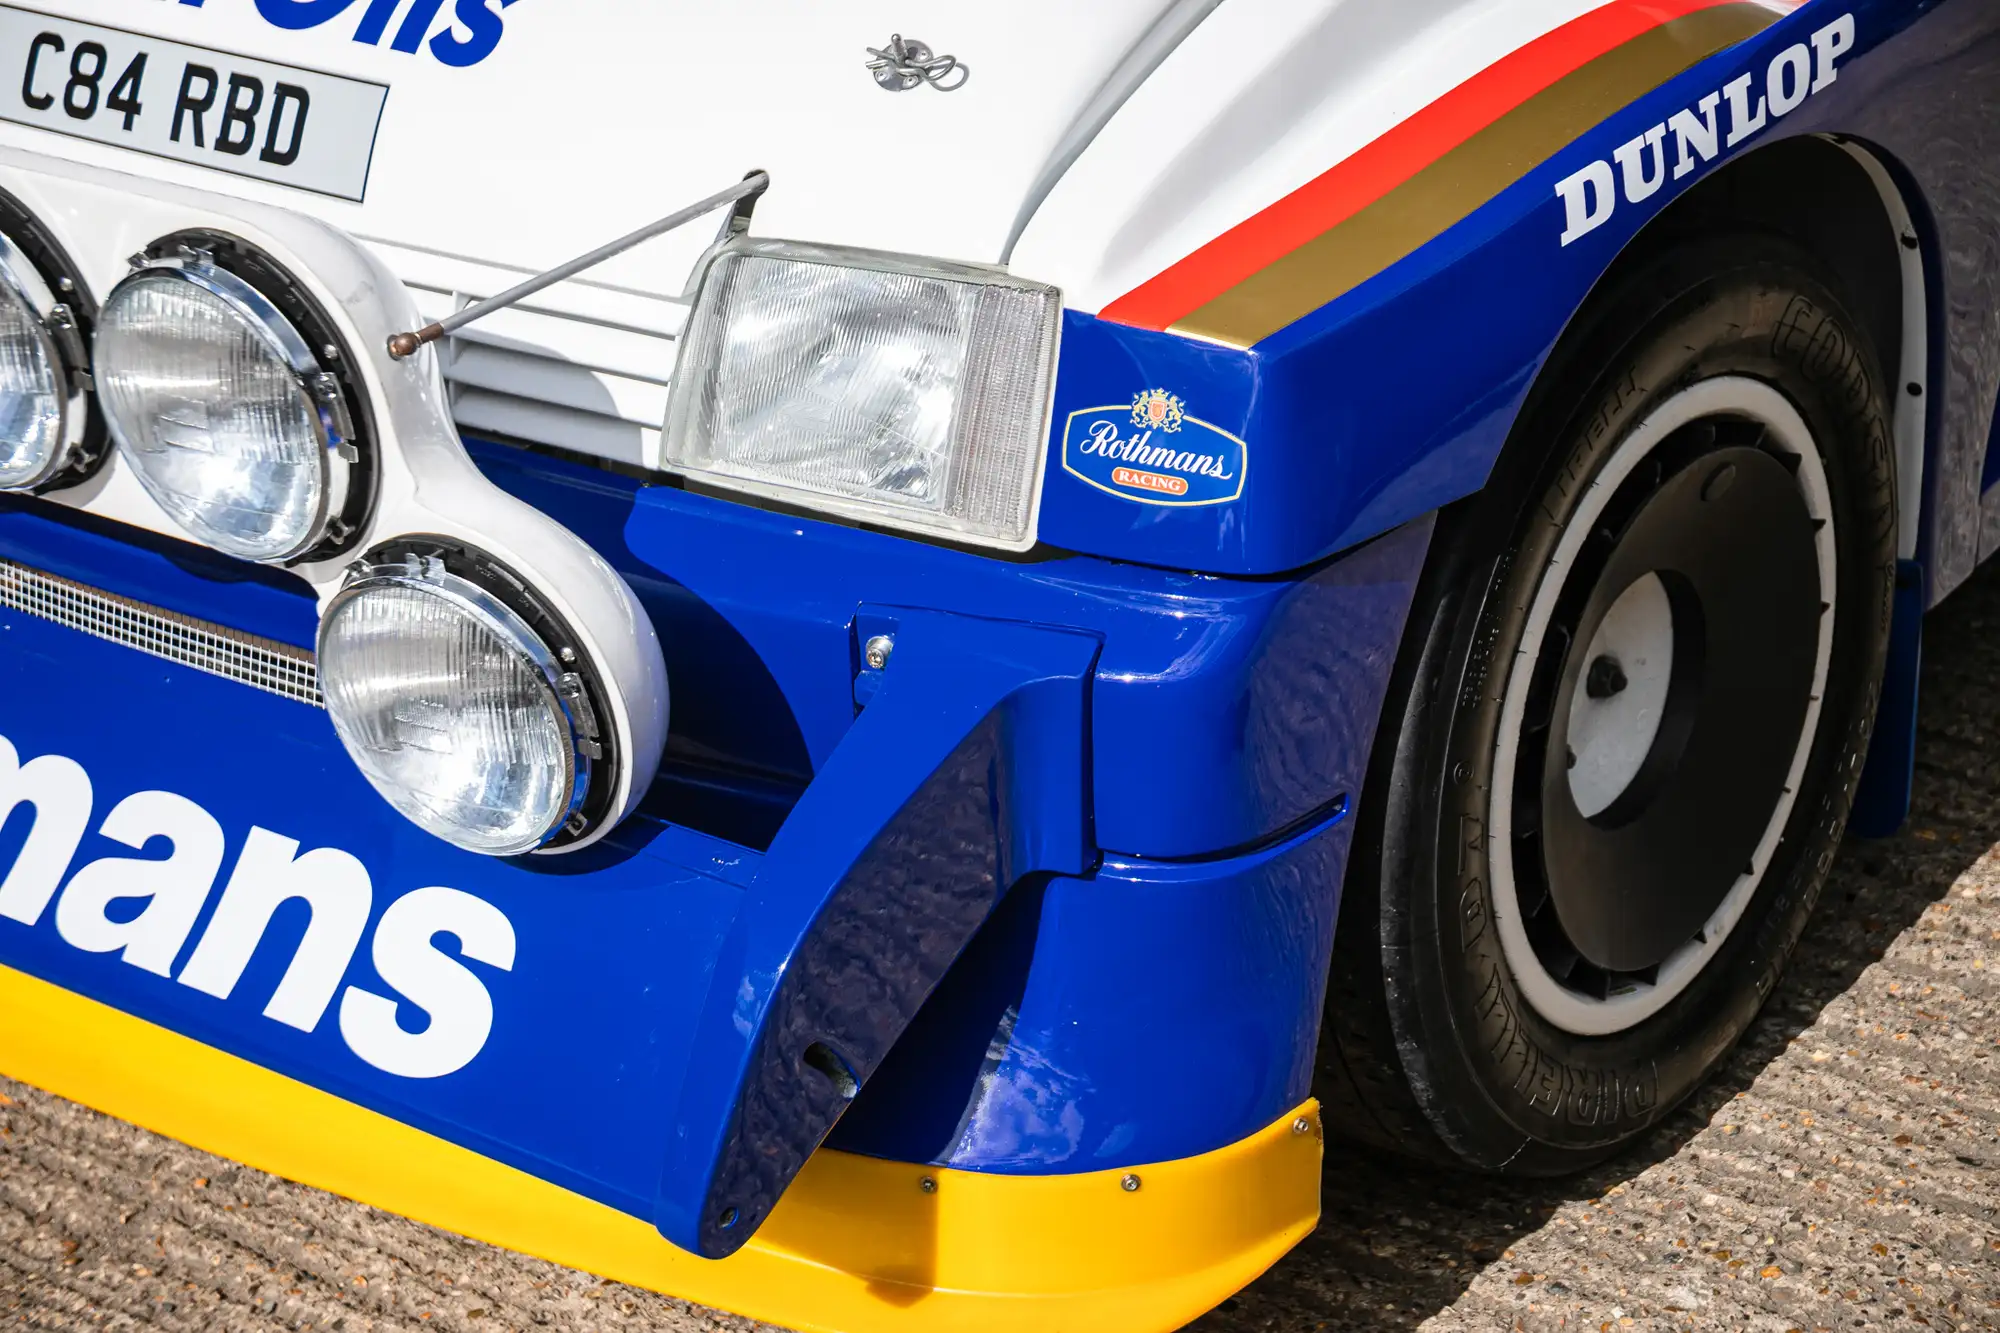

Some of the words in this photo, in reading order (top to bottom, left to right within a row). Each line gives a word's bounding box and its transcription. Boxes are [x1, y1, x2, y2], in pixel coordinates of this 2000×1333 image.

[21, 31, 149, 132] C84
[169, 62, 311, 167] RBD
[1554, 12, 1856, 248] DUNLOP
[1080, 420, 1233, 480] Rothmans
[1118, 469, 1181, 492] RACING
